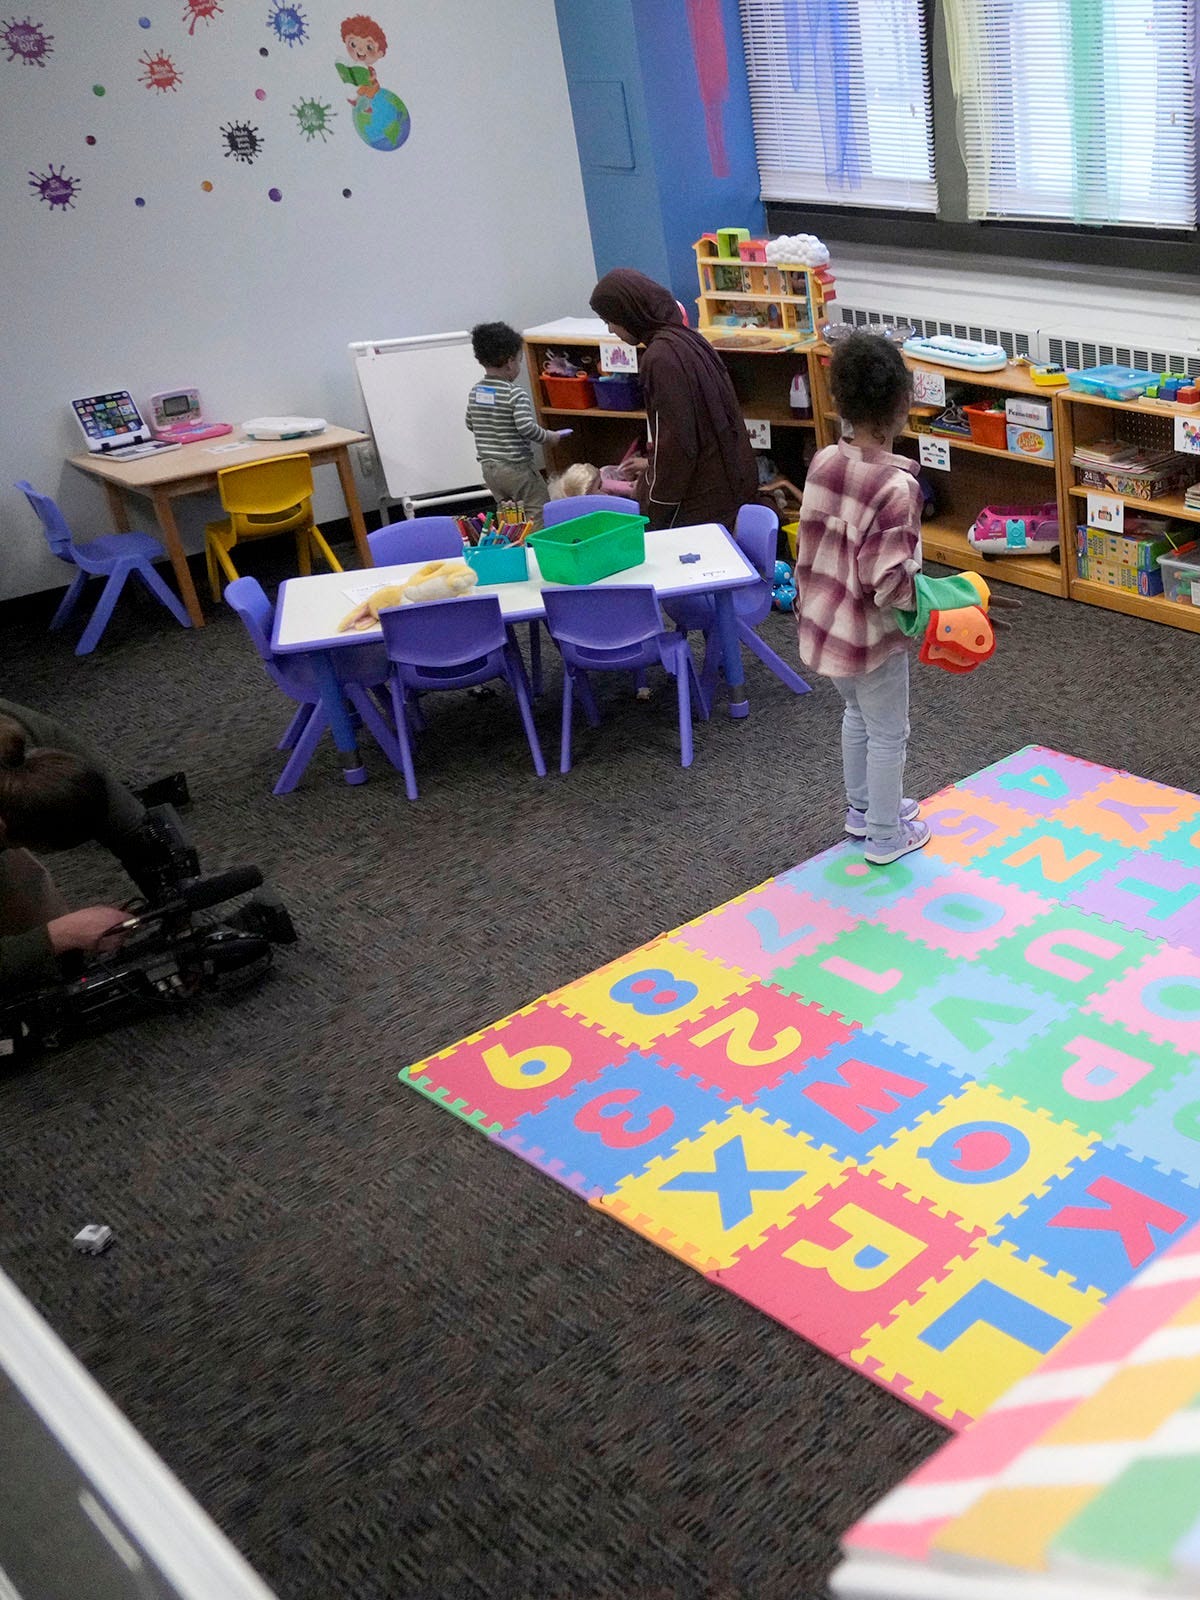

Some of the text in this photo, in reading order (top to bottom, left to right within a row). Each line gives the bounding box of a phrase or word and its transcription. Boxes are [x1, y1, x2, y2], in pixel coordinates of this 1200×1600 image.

[1084, 471, 1093, 481] 24
[998, 764, 1070, 800] 4
[928, 808, 999, 847] 5
[1096, 798, 1179, 834] Y
[746, 906, 816, 954] 7
[1024, 928, 1125, 983] U
[609, 968, 699, 1016] 8
[688, 1006, 802, 1067] 2
[929, 994, 1035, 1053] V
[1061, 1034, 1156, 1102] P
[574, 1088, 676, 1149] 3
[916, 1120, 1032, 1185] Q
[657, 1134, 808, 1232] X
[780, 1202, 930, 1293] R
[1046, 1175, 1189, 1270] K
[916, 1278, 1074, 1356] L
